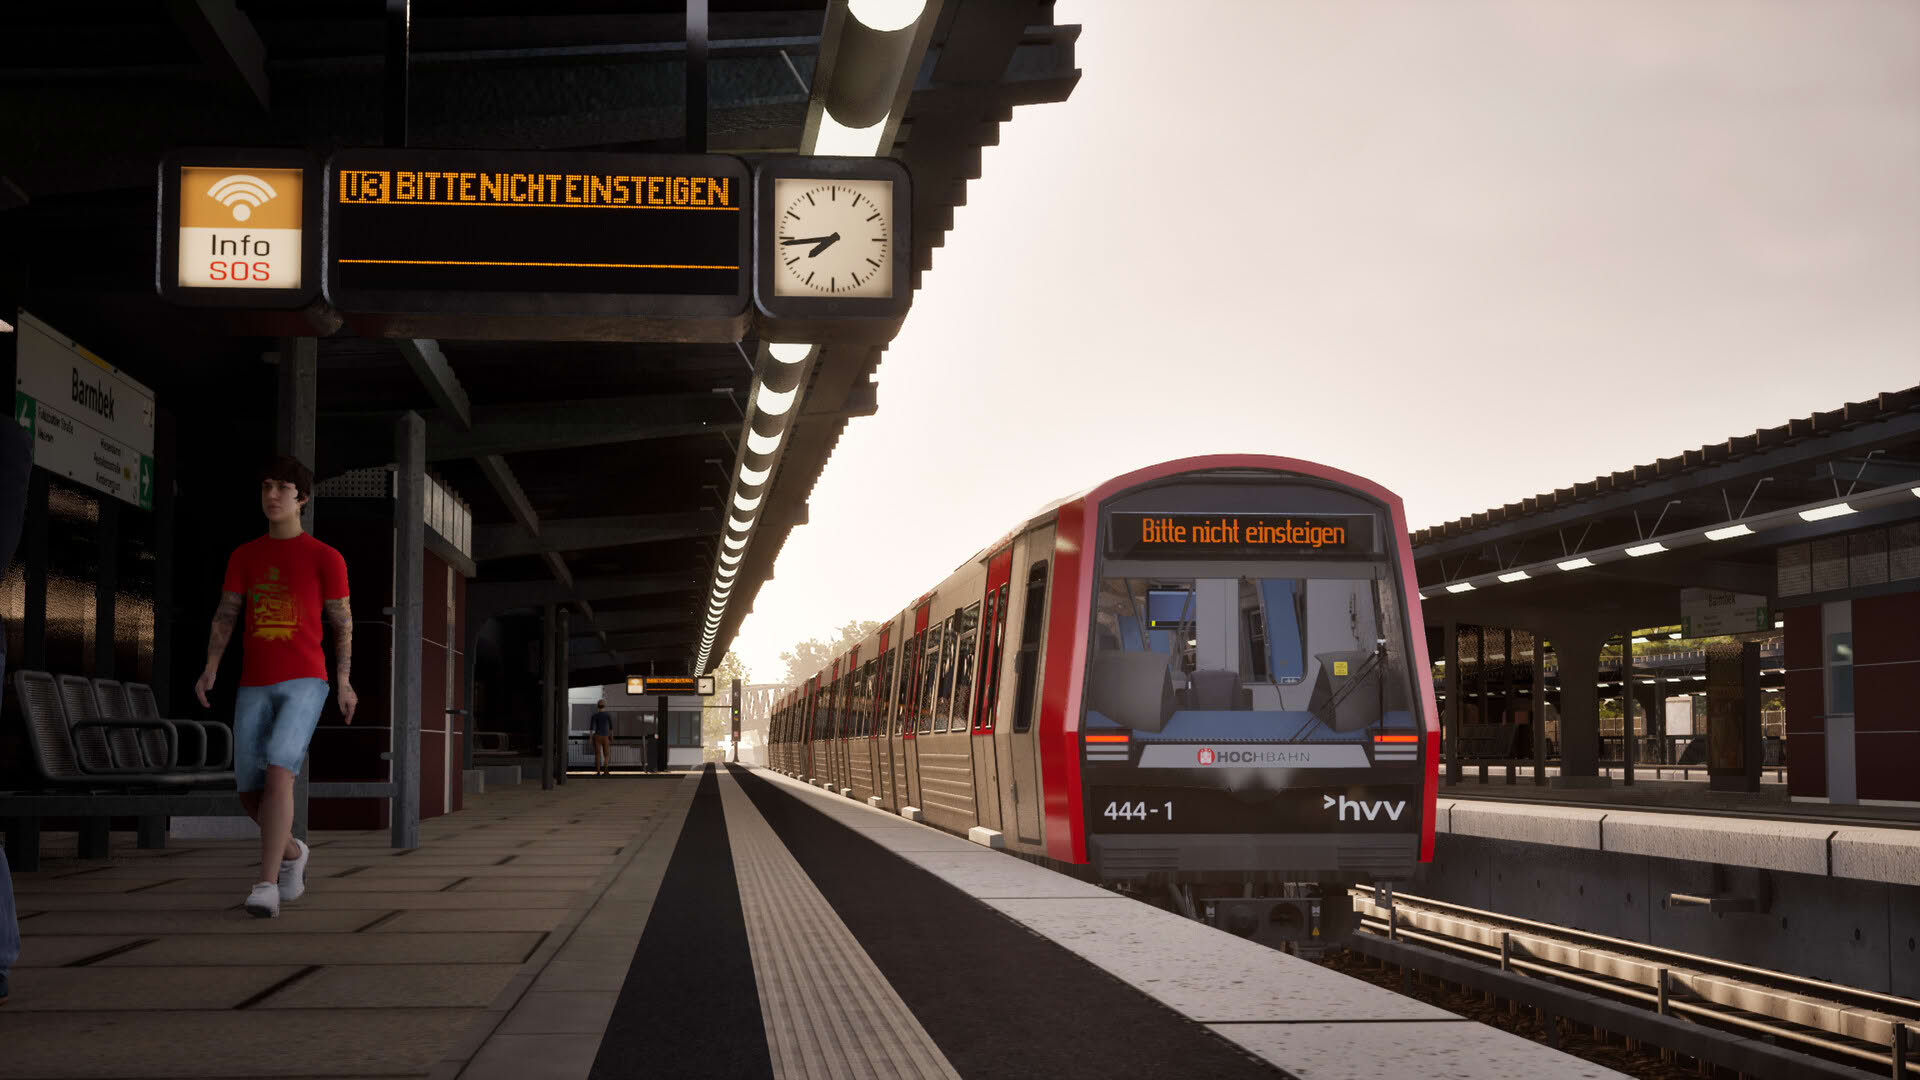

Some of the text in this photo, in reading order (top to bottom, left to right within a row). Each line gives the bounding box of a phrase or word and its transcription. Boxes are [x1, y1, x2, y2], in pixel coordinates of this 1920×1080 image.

[344, 172, 385, 201] U3
[565, 174, 729, 206] EINSTEIGEN
[211, 234, 271, 257] Info
[209, 261, 270, 282] SOS
[72, 367, 115, 422] Barmbek
[1142, 518, 1345, 548] Bitte nicht einsteigen
[1217, 751, 1311, 763] HOCHBAHN
